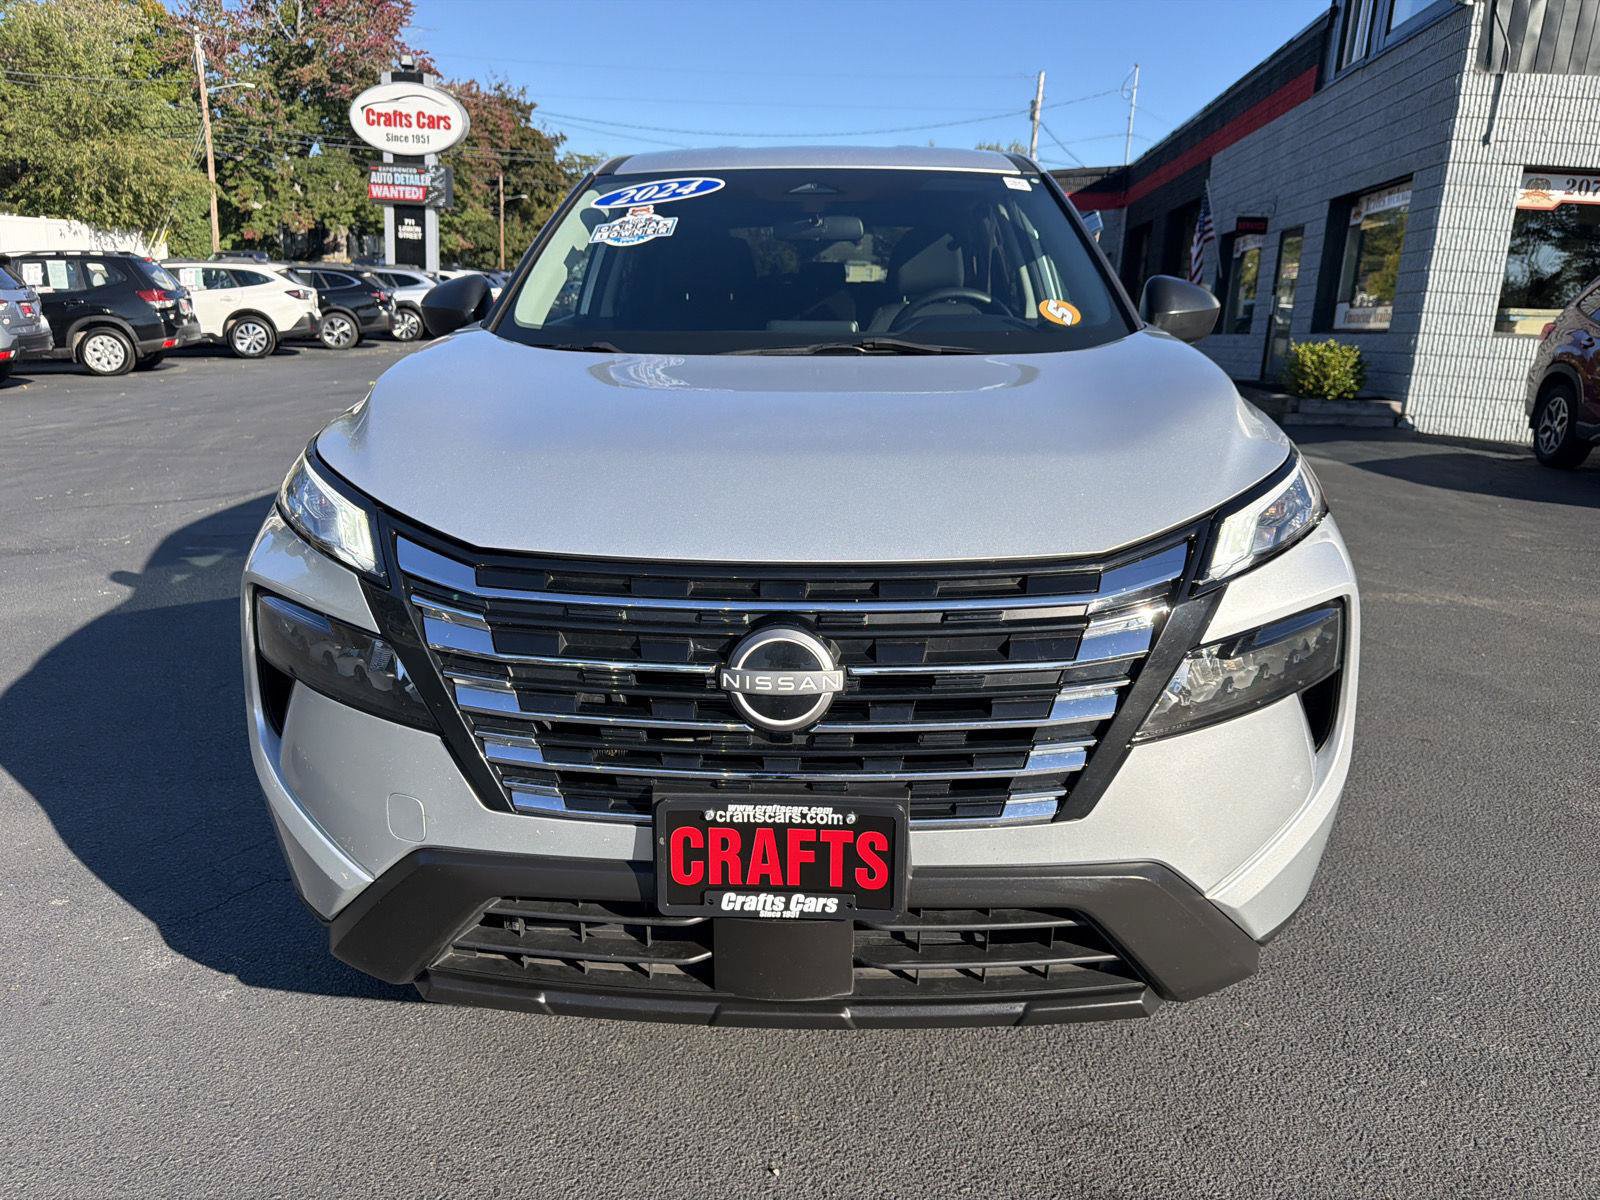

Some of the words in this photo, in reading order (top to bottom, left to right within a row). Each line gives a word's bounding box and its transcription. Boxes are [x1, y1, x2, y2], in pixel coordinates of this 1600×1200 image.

[365, 108, 412, 129] Crafts
[416, 110, 452, 131] Cars
[386, 132, 409, 144] Since
[411, 134, 430, 145] 1951
[370, 172, 393, 184] AUTO
[394, 173, 432, 186] DETAILER
[371, 185, 423, 200] WANTED!
[609, 179, 704, 205] 2024
[600, 219, 671, 233] CARFAX
[608, 226, 669, 239] OWNER
[722, 673, 839, 691] NISSAN
[727, 804, 833, 814] www.craftscars.com
[716, 810, 843, 825] craftscars.com
[670, 826, 889, 890] CRAFTS
[721, 892, 786, 912] Crafts
[789, 894, 839, 913] Cars
